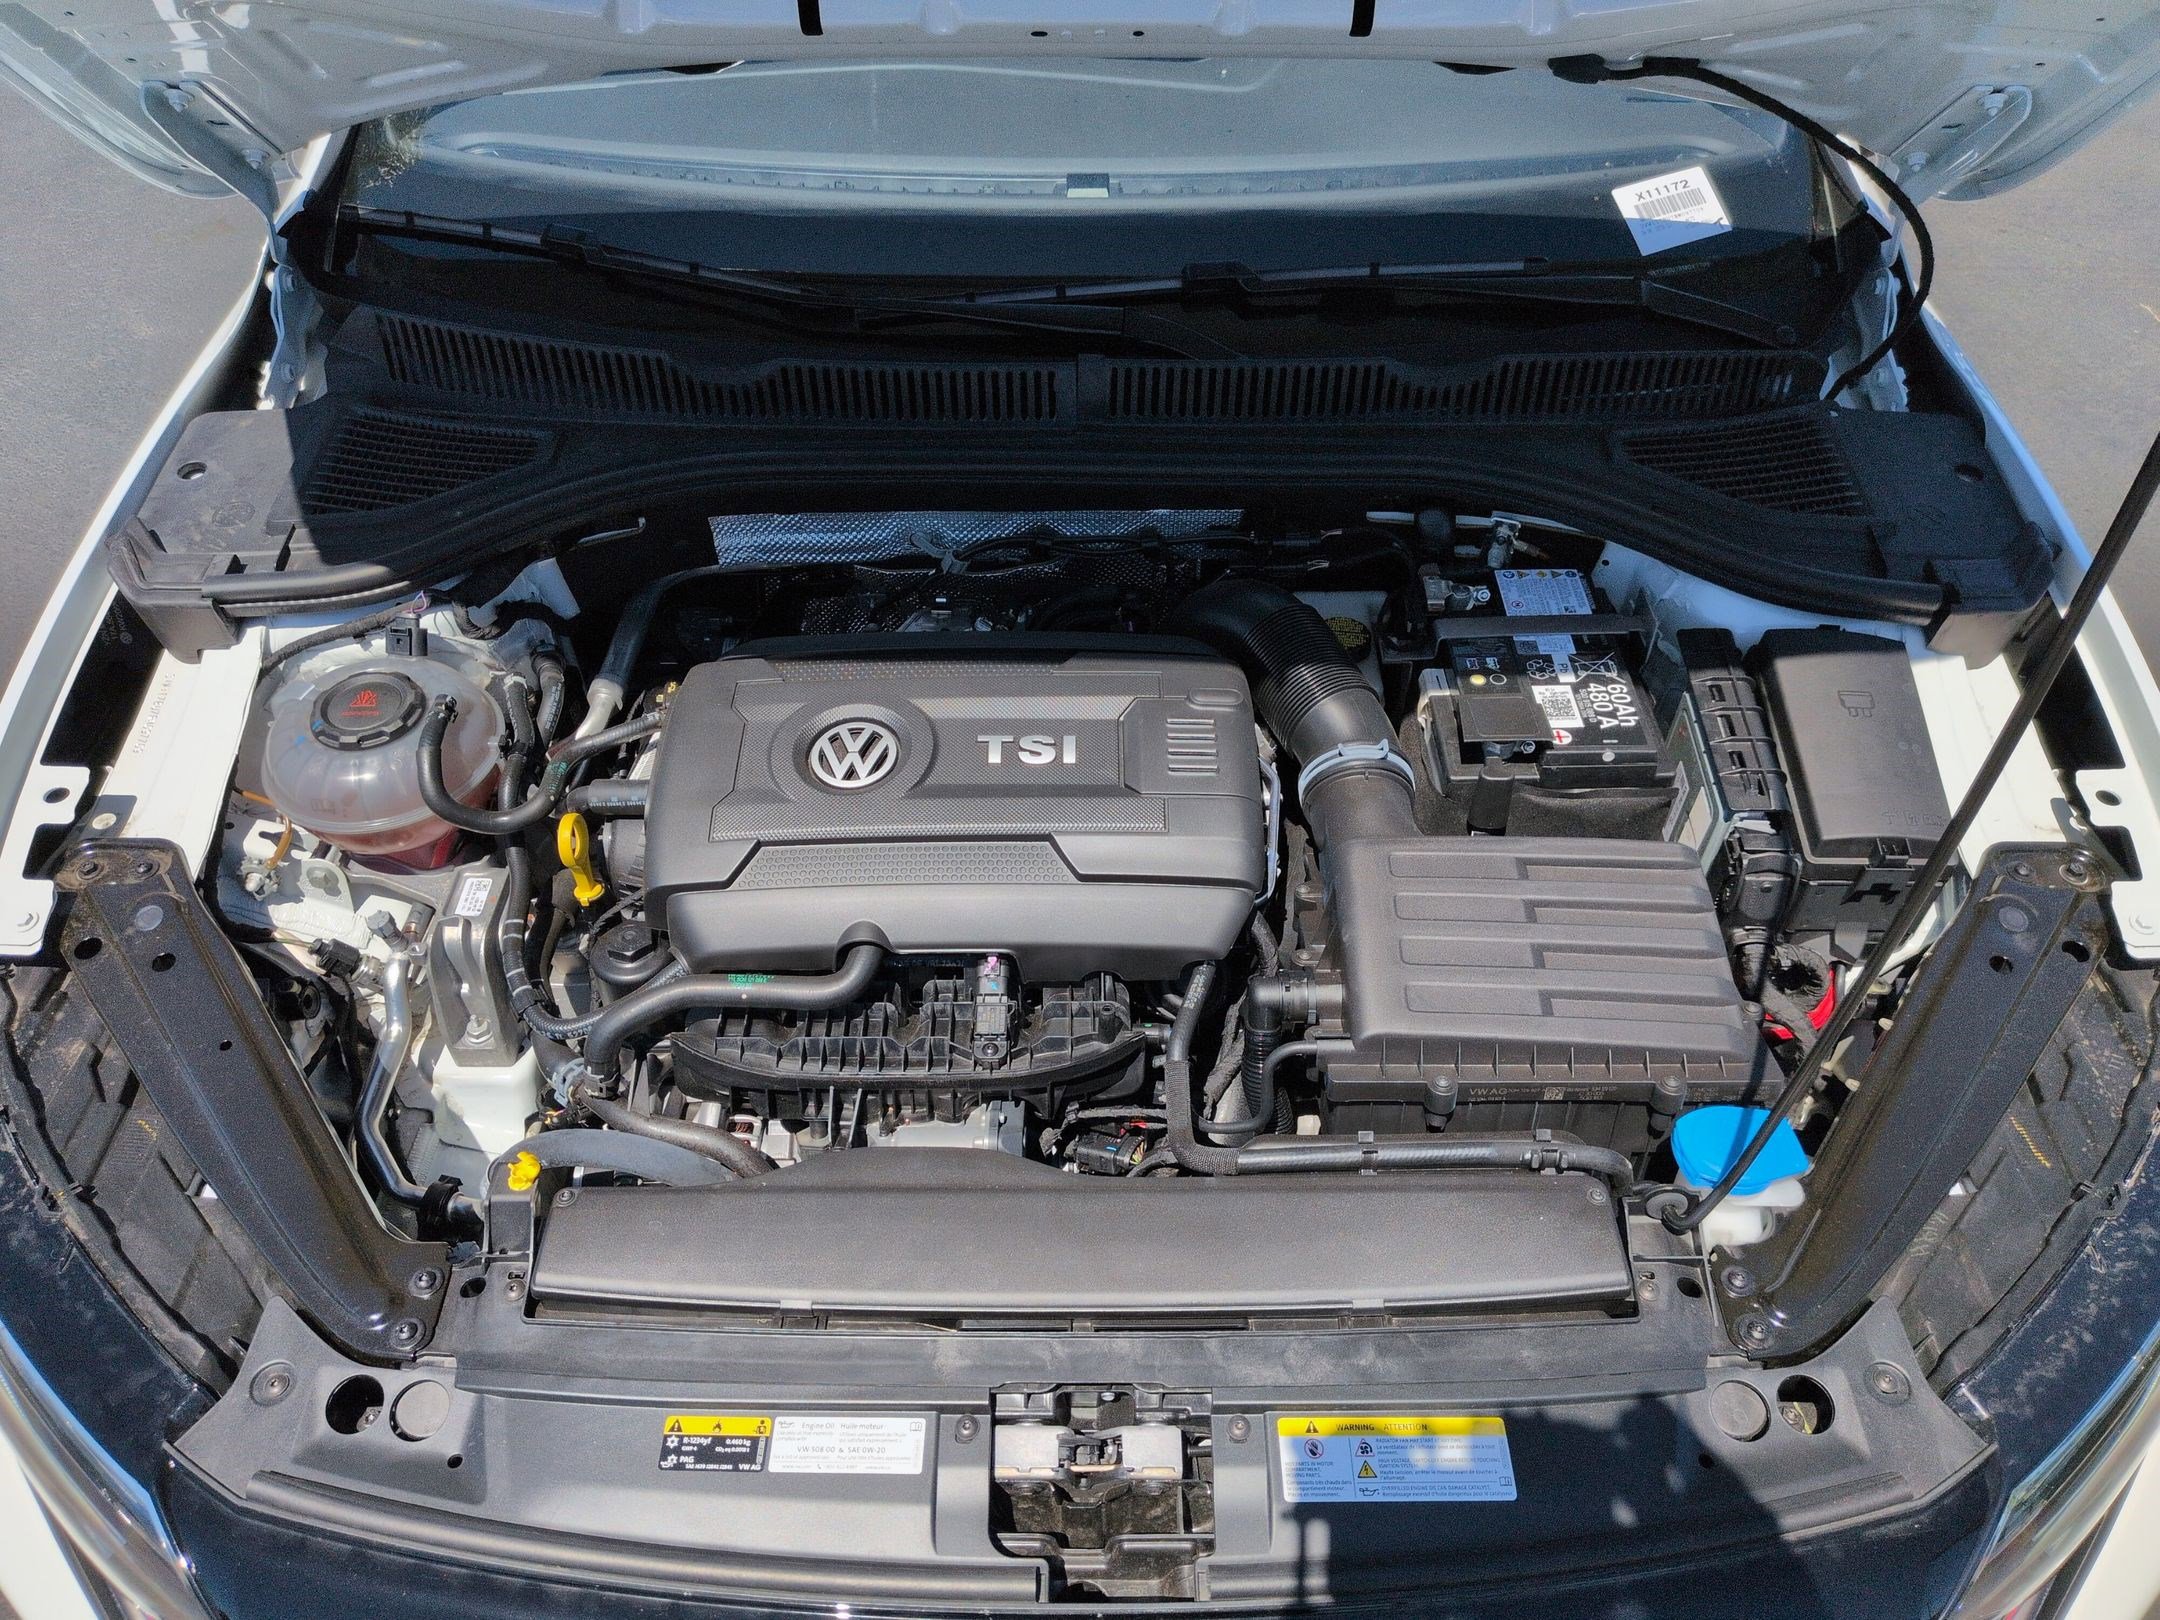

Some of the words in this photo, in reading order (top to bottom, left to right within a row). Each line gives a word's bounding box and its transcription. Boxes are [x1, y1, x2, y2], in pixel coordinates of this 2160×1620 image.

[1635, 179, 1690, 202] X11172
[1558, 663, 1569, 674] Pb
[1587, 682, 1614, 712] 480
[1607, 683, 1640, 727] 60Ah
[1600, 712, 1619, 729] A
[808, 721, 899, 789] VW
[977, 734, 1077, 764] TSI
[802, 1422, 825, 1431] Engine
[826, 1422, 835, 1430] Oil
[1335, 1423, 1375, 1432] WARNING
[1383, 1423, 1428, 1432] ATTENTION
